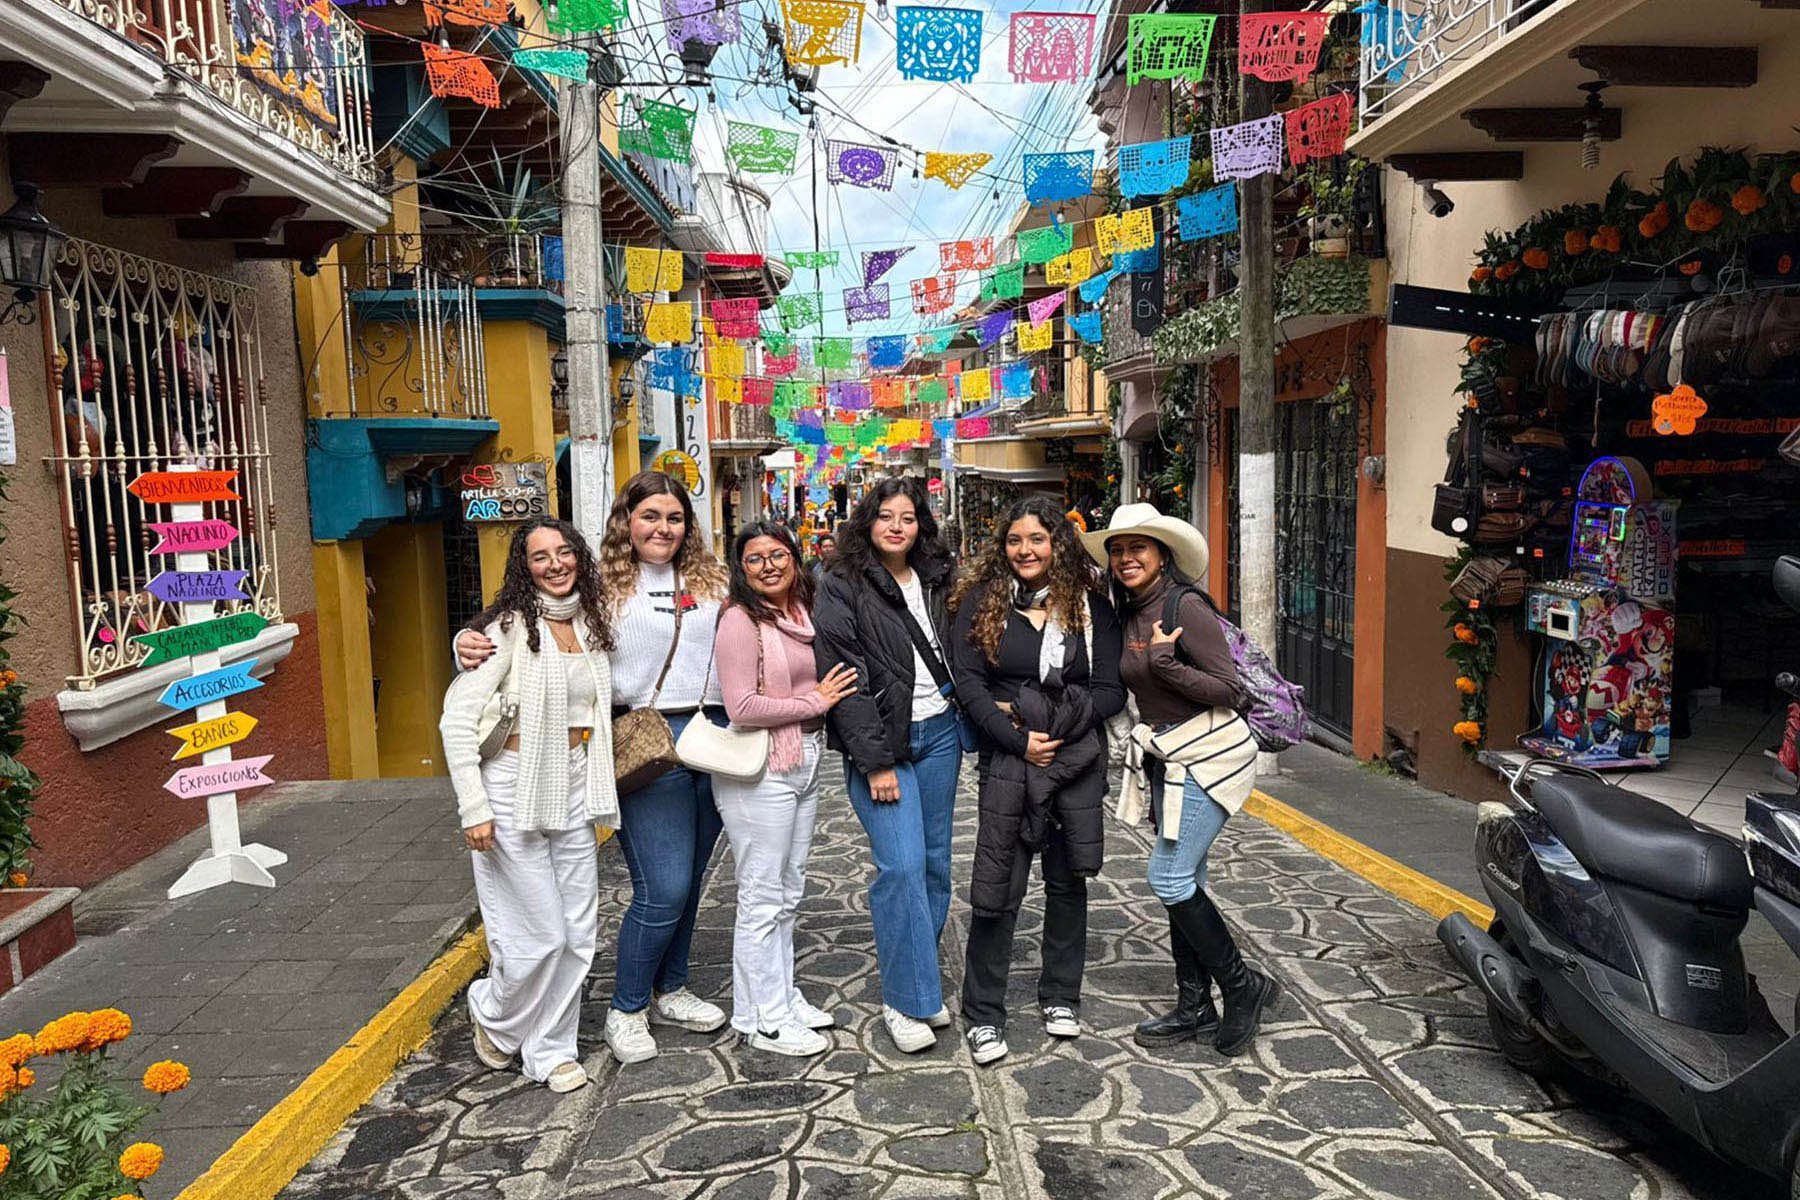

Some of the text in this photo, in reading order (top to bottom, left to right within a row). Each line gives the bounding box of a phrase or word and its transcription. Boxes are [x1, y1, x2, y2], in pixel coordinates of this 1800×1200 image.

[138, 479, 225, 498] BIENVENIDOS
[466, 497, 544, 519] ARCOS
[166, 525, 228, 546] NAOLINCO
[1631, 526, 1646, 597] MARIO
[1658, 507, 1673, 595] DELUXE
[1643, 536, 1656, 597] KART
[167, 583, 227, 598] NAOLINCO
[176, 573, 224, 587] PLAZA
[175, 673, 246, 703] ACCESORIOS
[179, 766, 259, 793] EXPOSICIONES
